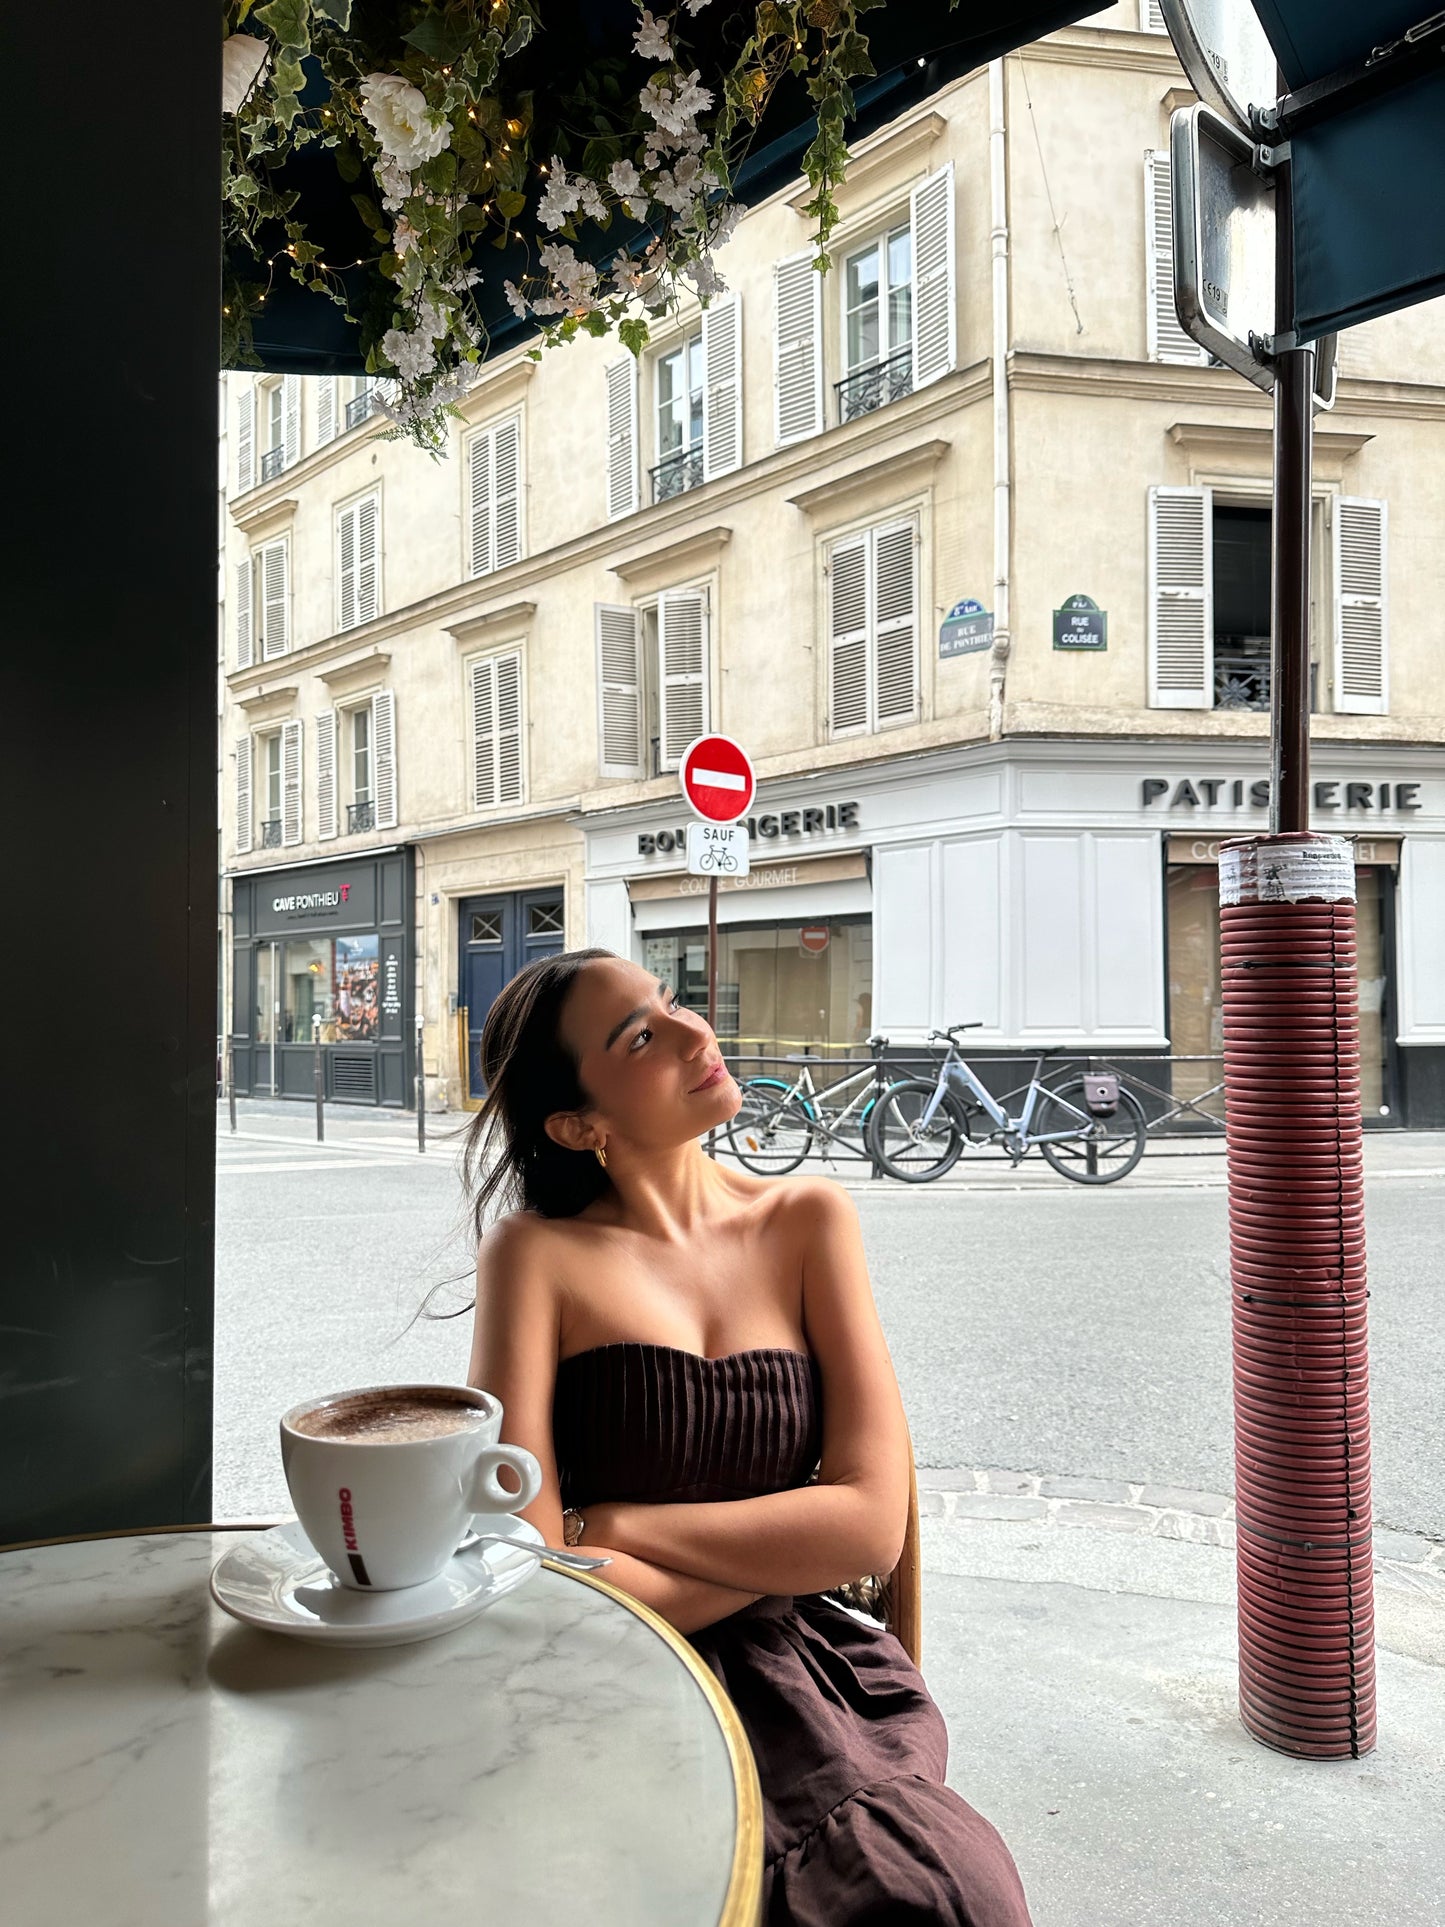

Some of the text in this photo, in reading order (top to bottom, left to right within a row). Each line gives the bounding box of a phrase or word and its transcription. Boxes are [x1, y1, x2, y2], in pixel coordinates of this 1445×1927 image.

[957, 624, 977, 637] RUE
[1070, 616, 1090, 627] RUE
[1142, 779, 1422, 810] PATISERIE
[637, 801, 859, 855] BOUNGERIE
[703, 827, 735, 842] SAUF
[734, 866, 799, 889] GOURMET
[272, 891, 339, 912] CAVE PONTHIEU
[339, 1487, 358, 1551] KIMBO
